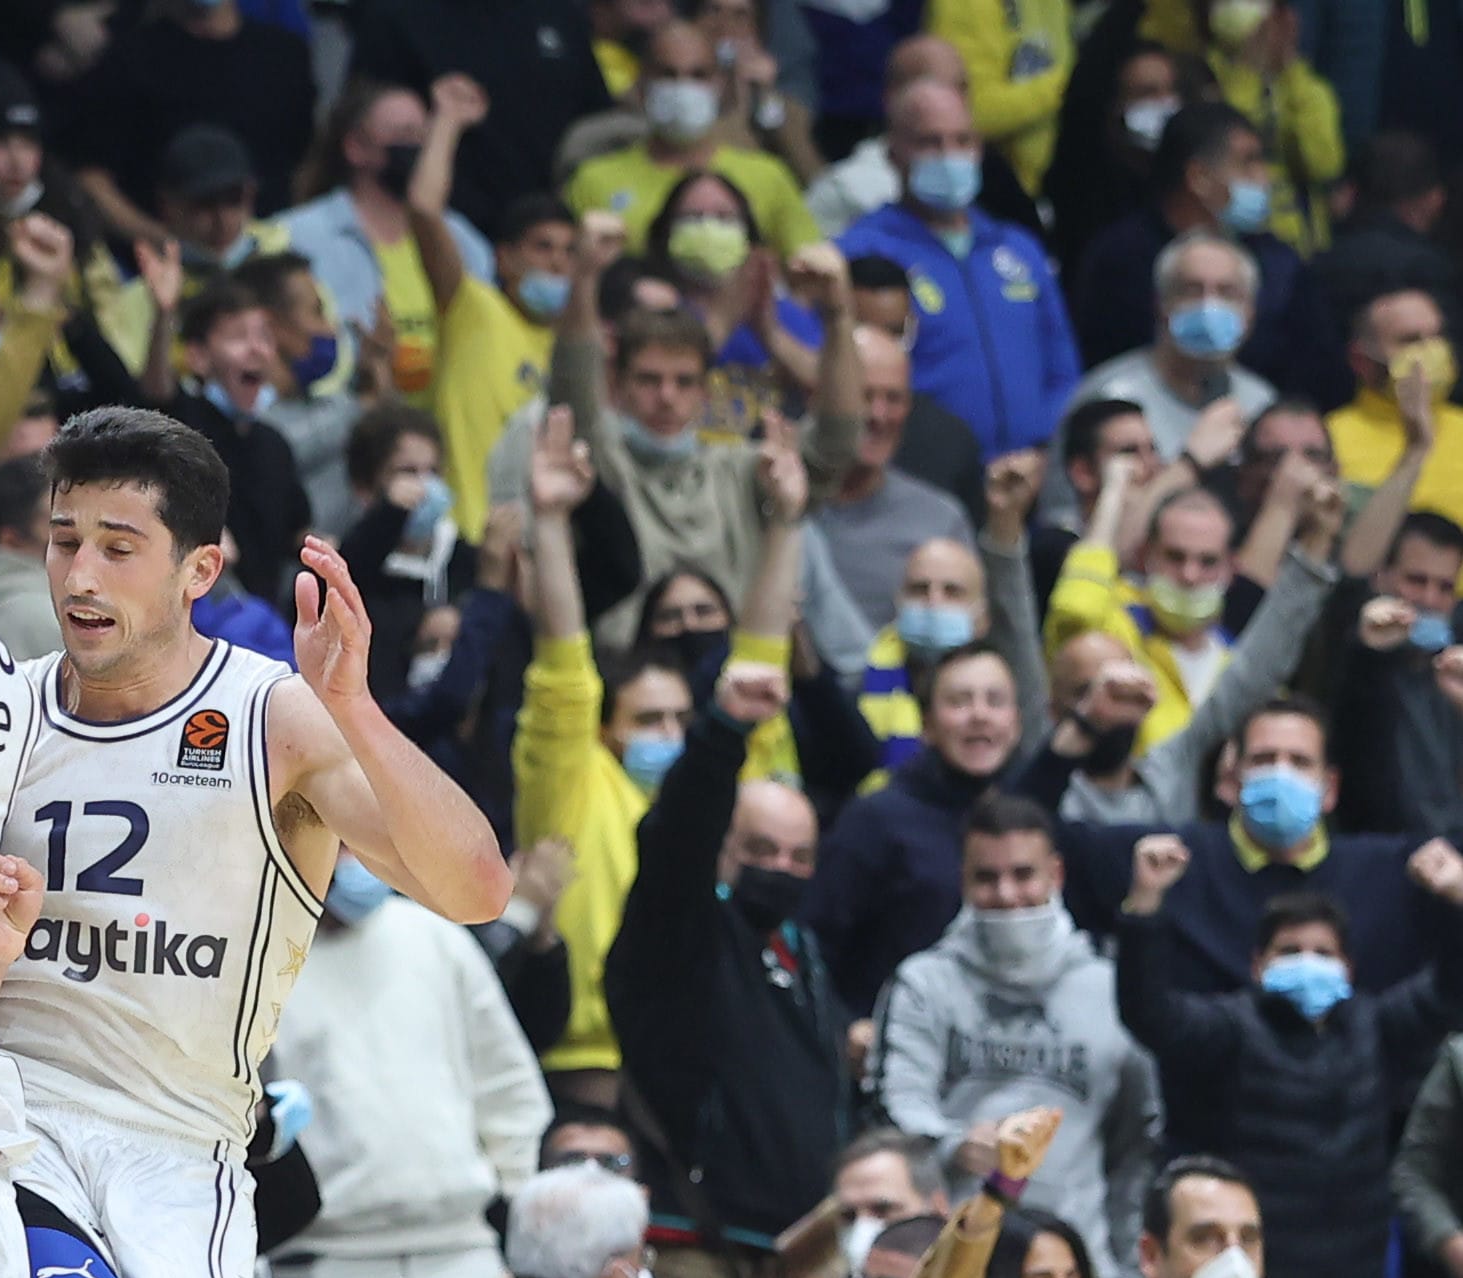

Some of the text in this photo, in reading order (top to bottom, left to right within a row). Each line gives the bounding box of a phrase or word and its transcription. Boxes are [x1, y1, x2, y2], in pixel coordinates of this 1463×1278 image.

[182, 755, 221, 763] AIRLINES
[183, 747, 222, 756] TURKISH
[34, 800, 150, 897] 12
[23, 912, 228, 983] aytika
